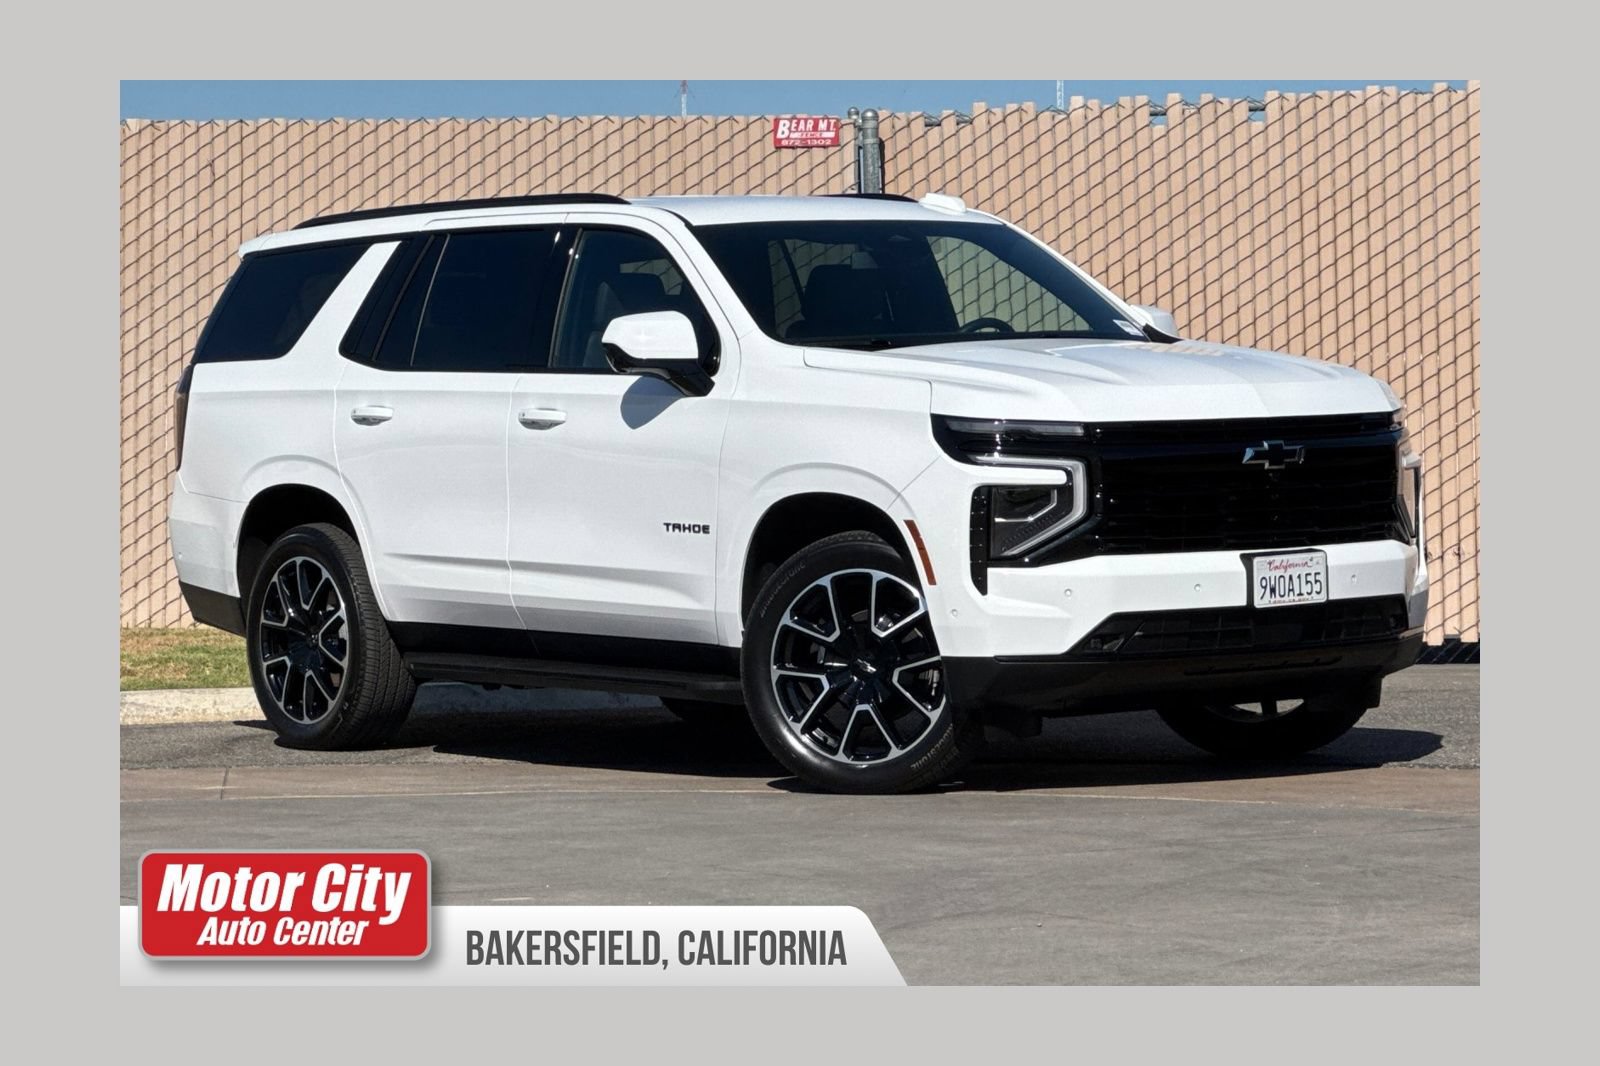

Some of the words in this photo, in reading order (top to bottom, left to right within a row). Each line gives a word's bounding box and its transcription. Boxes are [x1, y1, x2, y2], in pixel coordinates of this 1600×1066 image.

[776, 119, 814, 138] BEAR
[663, 522, 710, 535] TAHOE
[1267, 558, 1312, 573] California
